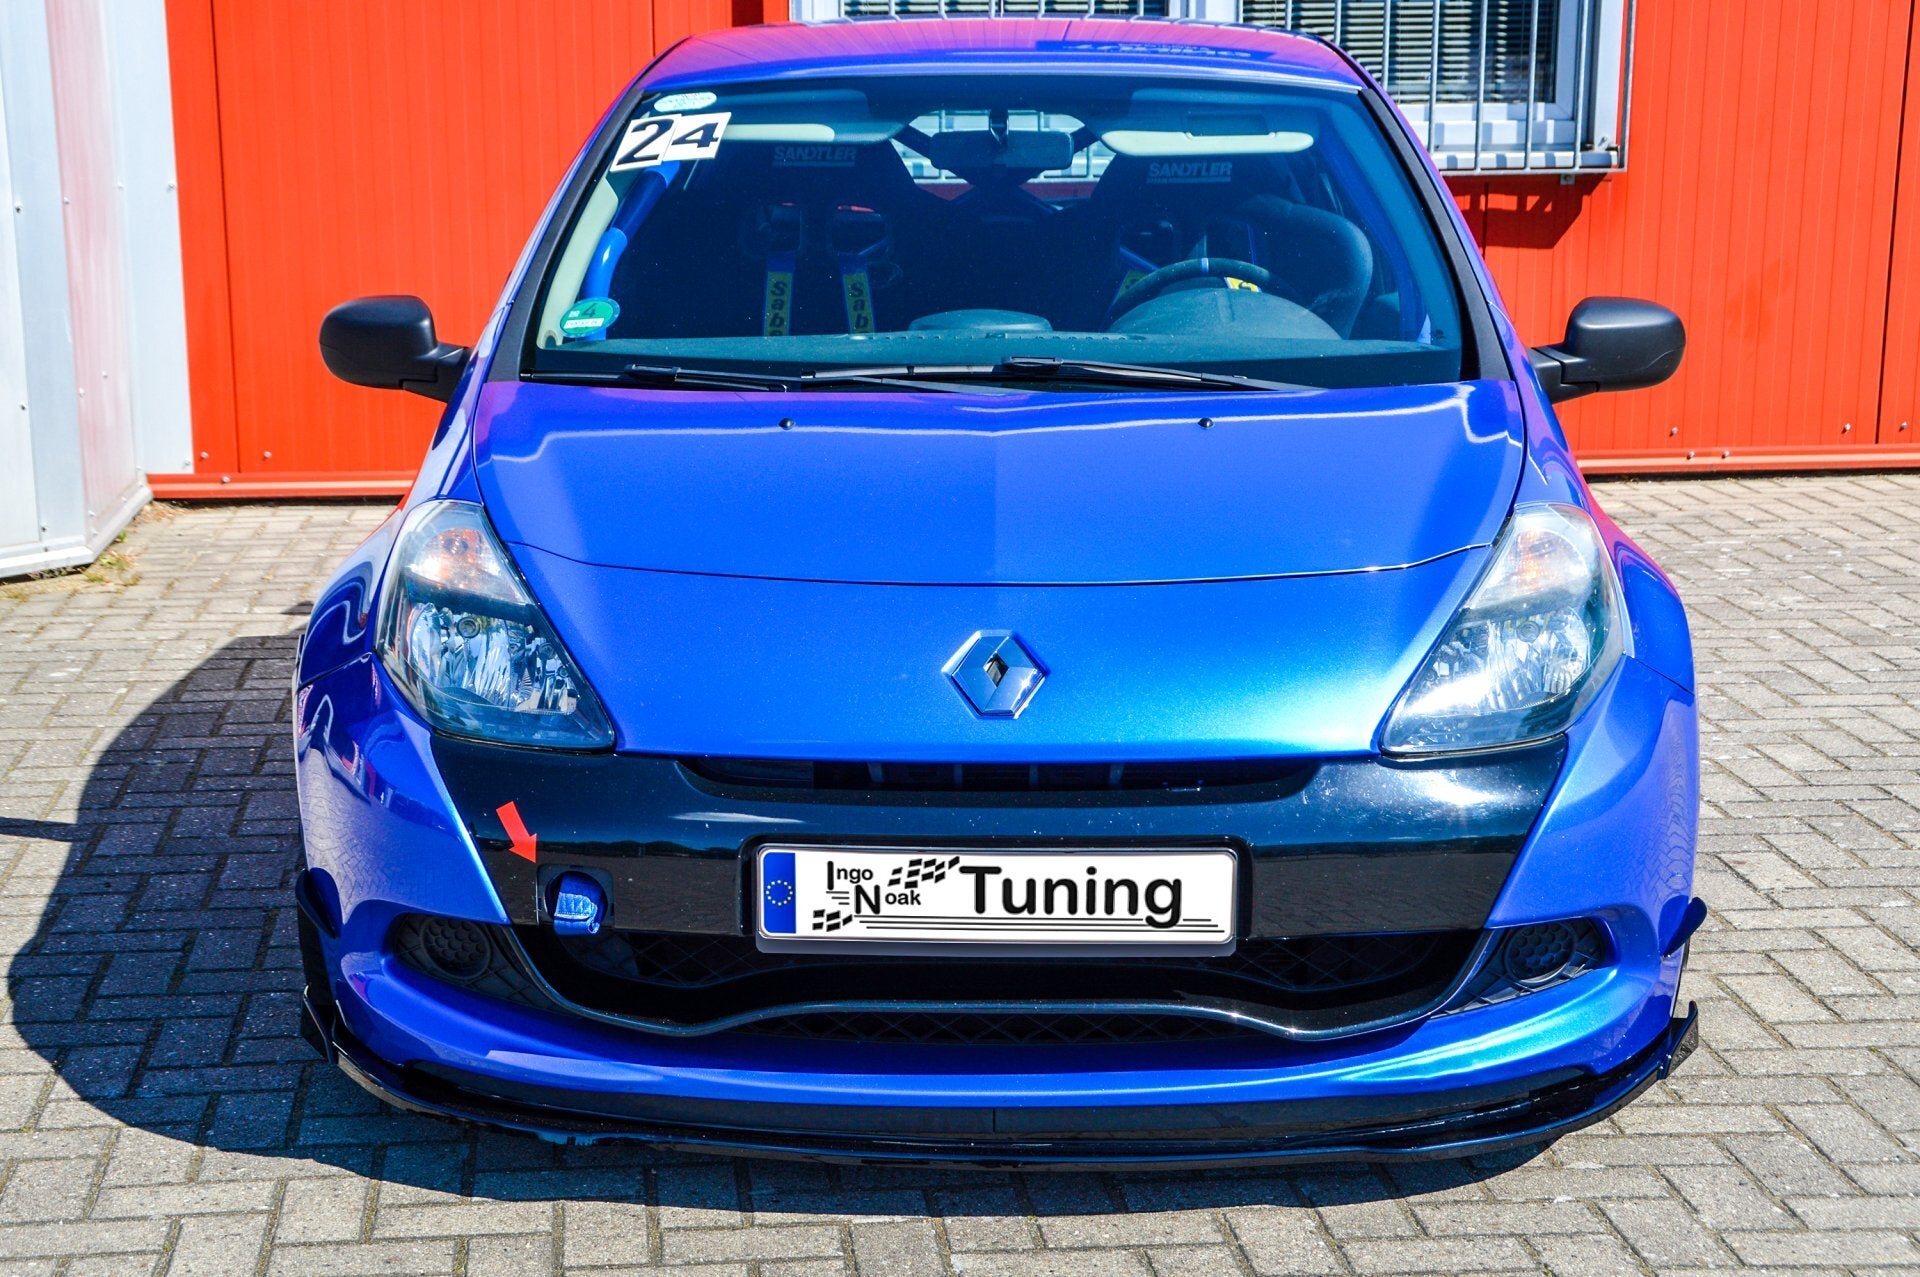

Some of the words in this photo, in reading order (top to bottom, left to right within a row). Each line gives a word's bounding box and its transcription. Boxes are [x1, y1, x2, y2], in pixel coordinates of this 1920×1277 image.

[616, 118, 719, 166] 24
[773, 145, 857, 161] SANDTLER
[1149, 161, 1233, 176] SANDTLER
[582, 302, 598, 318] 4
[827, 861, 874, 891] Ingo
[854, 885, 922, 915] Noak
[958, 865, 1183, 929] Tuning
